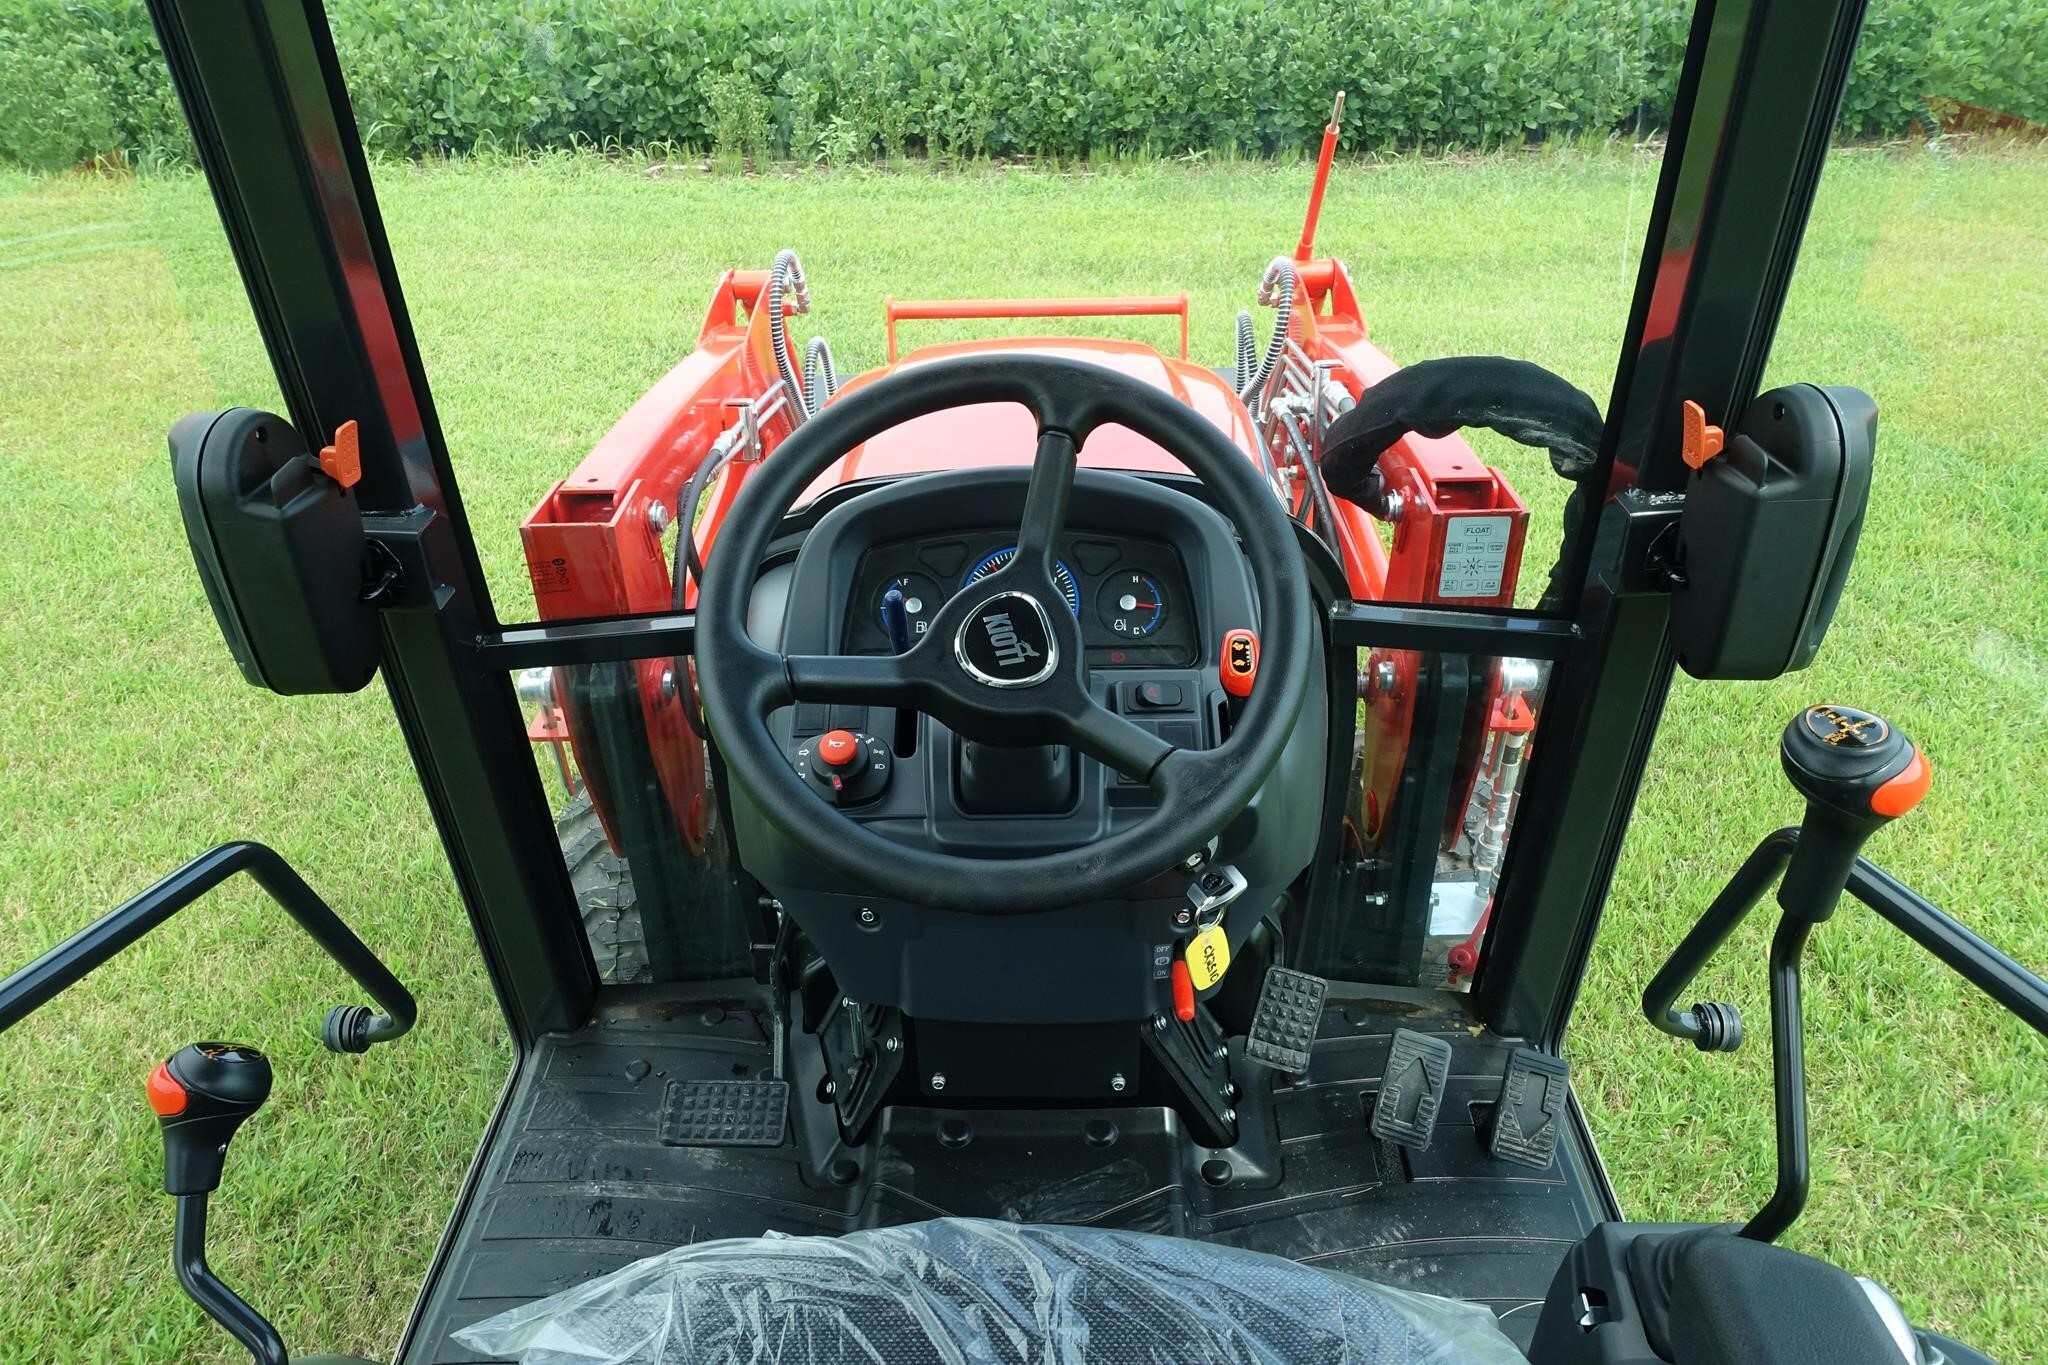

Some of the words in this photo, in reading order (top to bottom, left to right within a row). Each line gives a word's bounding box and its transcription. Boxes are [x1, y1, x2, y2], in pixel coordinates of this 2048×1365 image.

[903, 578, 909, 586] F
[1132, 575, 1139, 583] H
[1133, 627, 1140, 635] C
[983, 613, 1026, 667] KIOTI
[1156, 945, 1169, 953] OFF
[1203, 944, 1219, 983] CX2510
